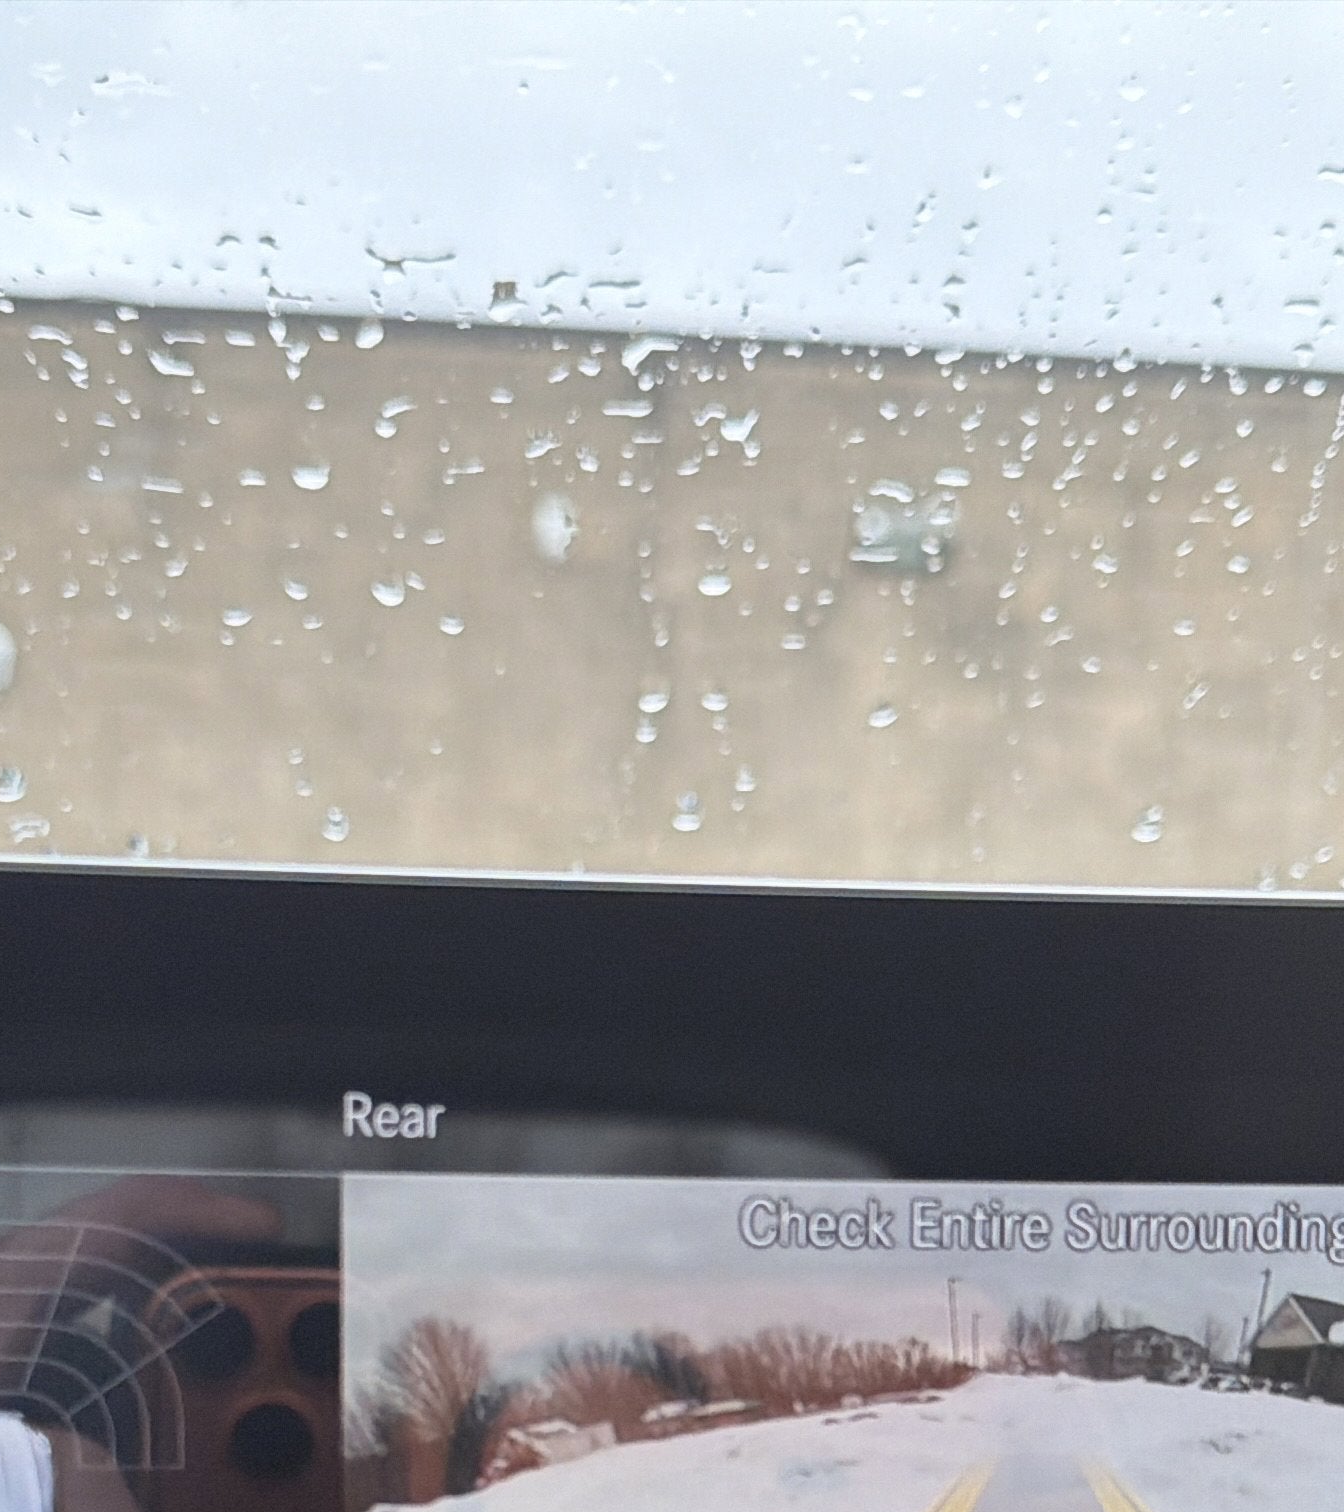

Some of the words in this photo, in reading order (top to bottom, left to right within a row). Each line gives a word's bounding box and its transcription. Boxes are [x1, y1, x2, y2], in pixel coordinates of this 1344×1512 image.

[342, 1090, 446, 1139] Rear
[739, 1197, 895, 1251] Check
[909, 1198, 1051, 1252] Entire
